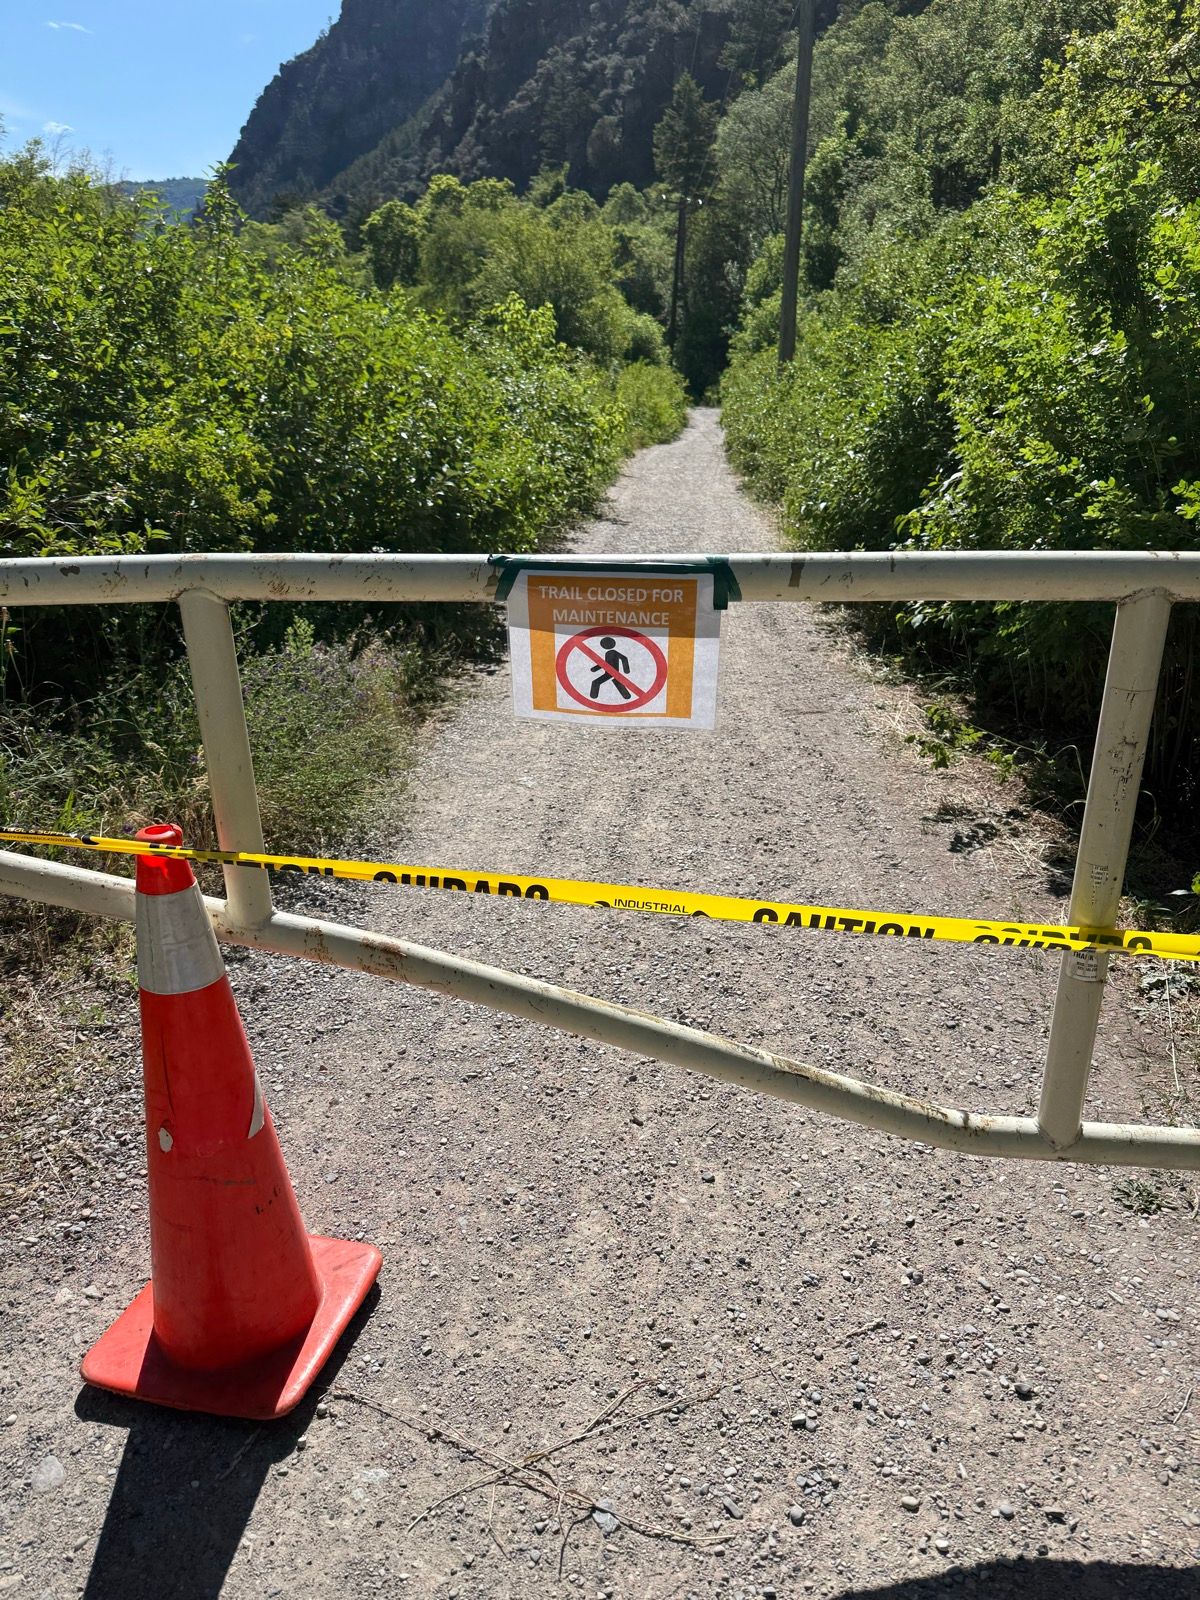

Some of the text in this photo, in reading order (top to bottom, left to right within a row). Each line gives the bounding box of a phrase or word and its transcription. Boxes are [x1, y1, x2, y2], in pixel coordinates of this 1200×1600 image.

[538, 585, 684, 604] TRAIL CLOSED FOR
[552, 609, 670, 625] MAINTENANCE
[614, 898, 689, 913] INDUSTRIAL
